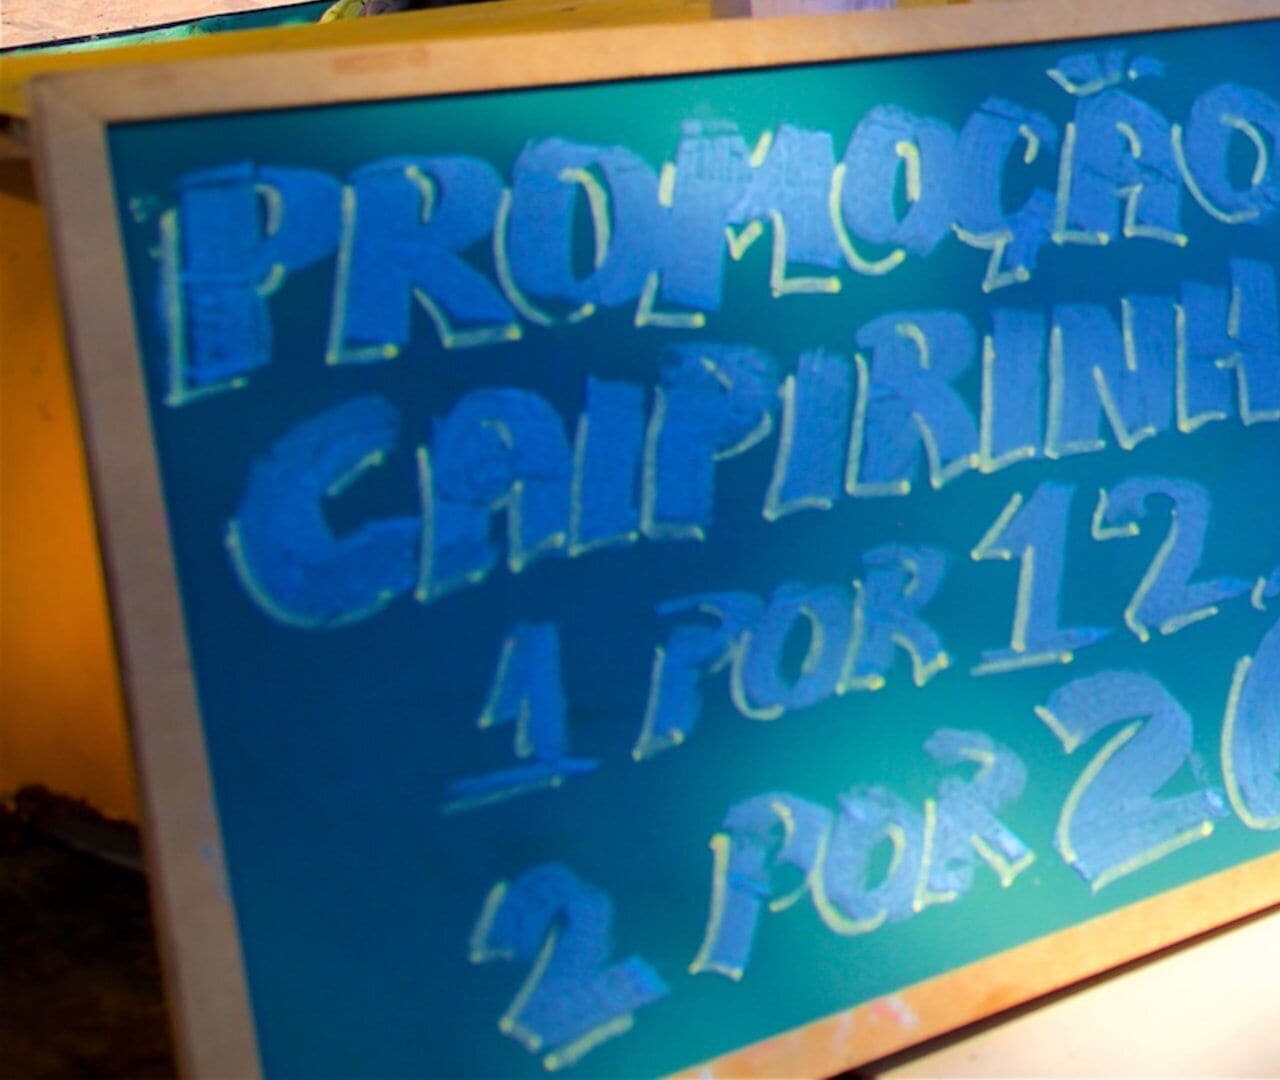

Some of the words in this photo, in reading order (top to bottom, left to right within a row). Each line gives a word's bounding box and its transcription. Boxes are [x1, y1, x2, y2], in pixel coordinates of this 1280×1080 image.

[440, 622, 600, 813] 1
[632, 544, 952, 760] POR
[470, 863, 670, 1070] 2
[690, 728, 1034, 980] POR
